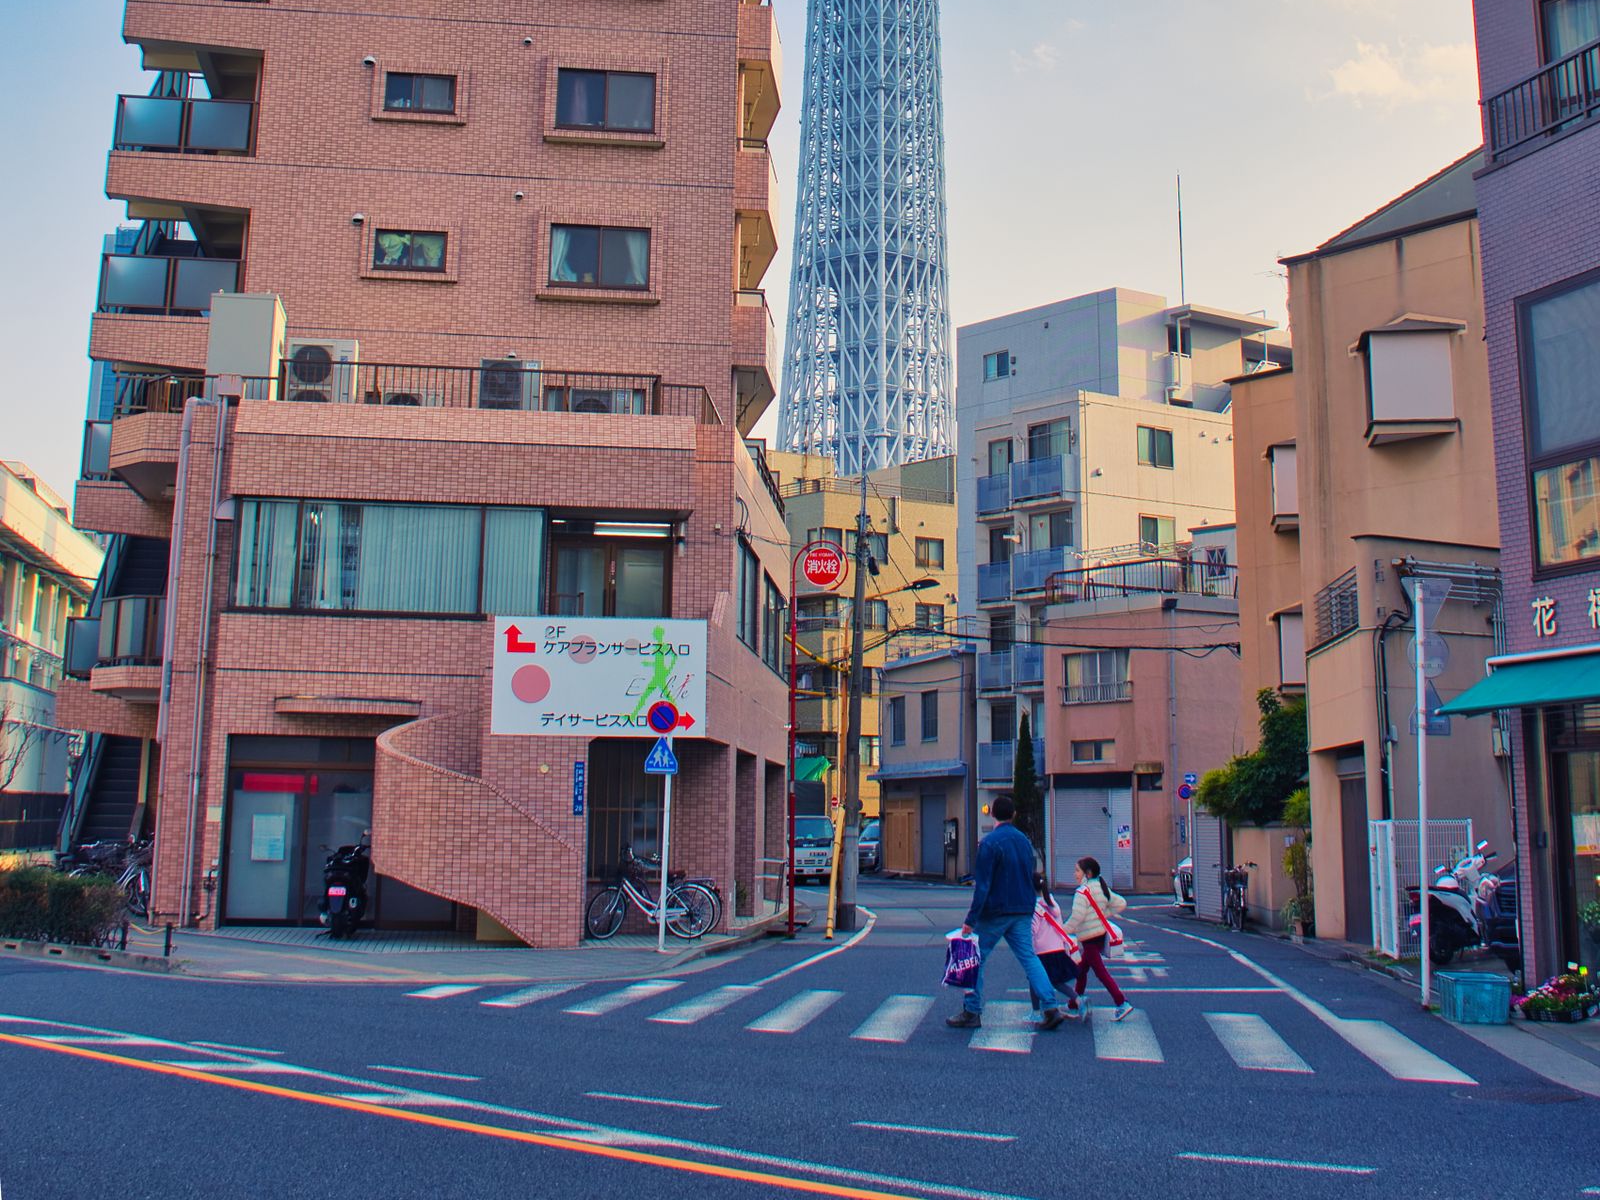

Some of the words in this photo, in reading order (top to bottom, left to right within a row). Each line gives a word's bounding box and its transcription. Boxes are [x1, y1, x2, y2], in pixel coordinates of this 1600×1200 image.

[807, 559, 838, 574] 消火栓
[544, 626, 566, 639] 2F
[543, 640, 690, 656] ケアプランサービス入口
[541, 712, 648, 727] デイサービス入口
